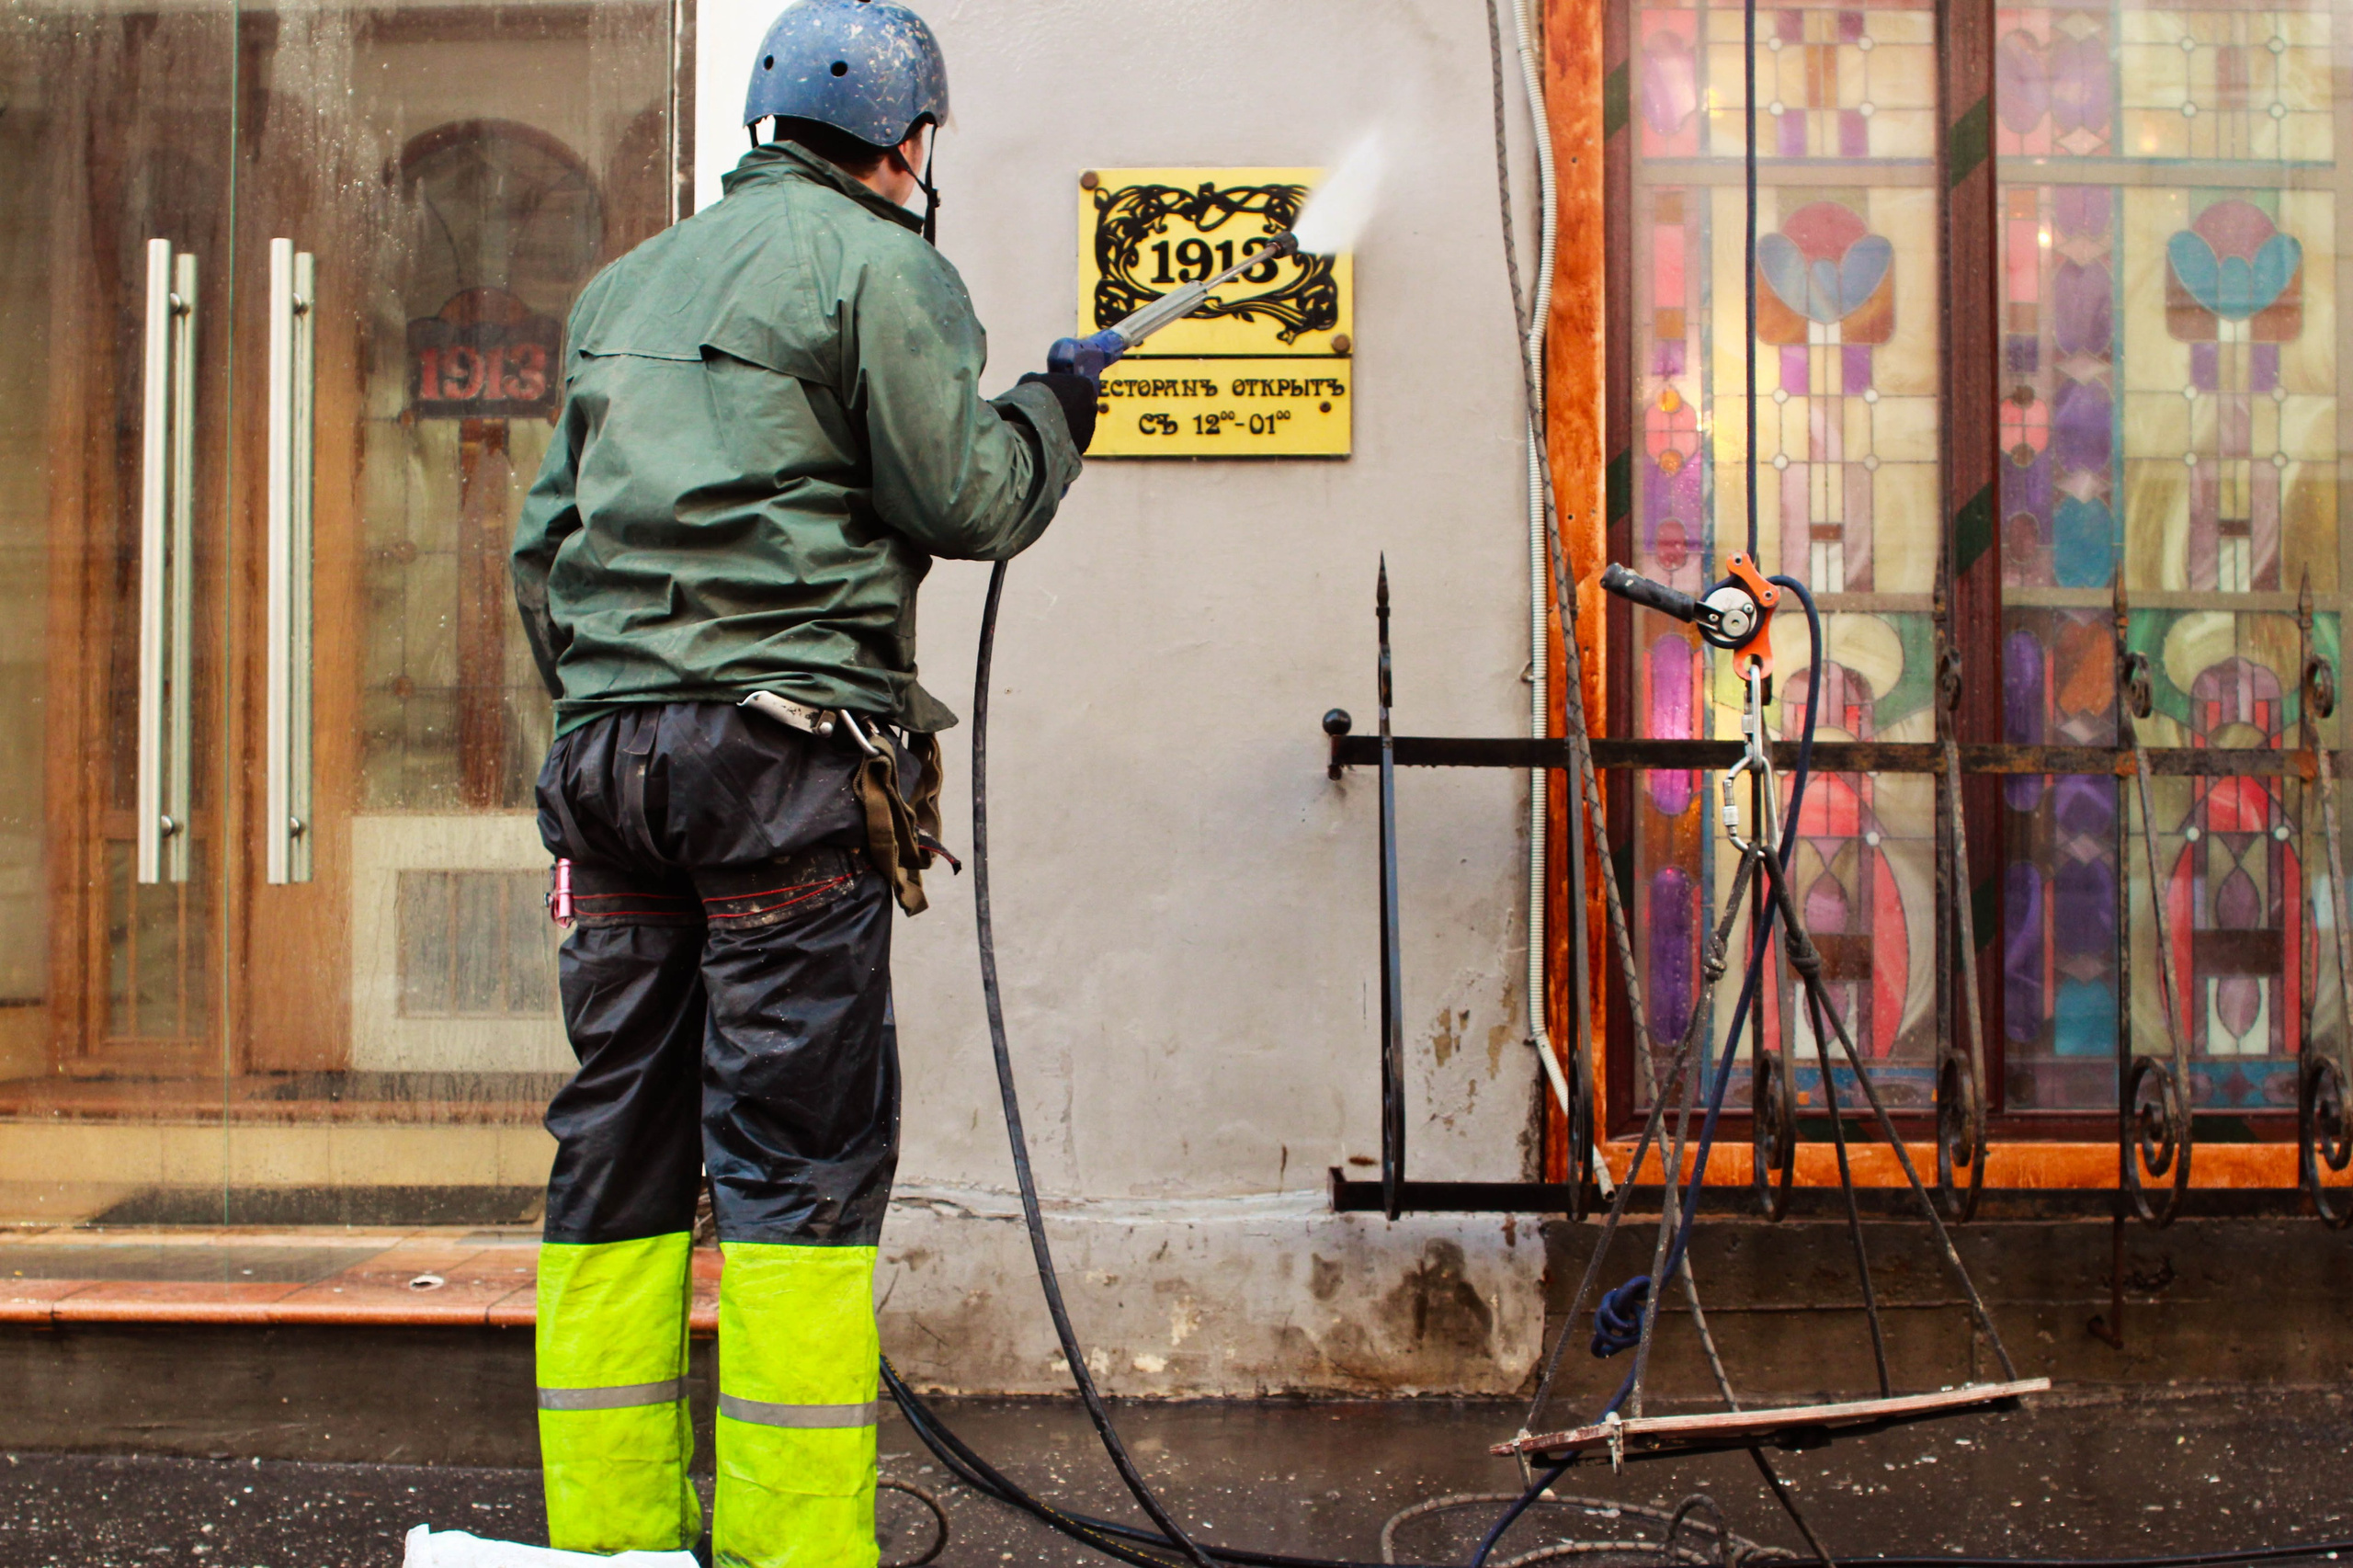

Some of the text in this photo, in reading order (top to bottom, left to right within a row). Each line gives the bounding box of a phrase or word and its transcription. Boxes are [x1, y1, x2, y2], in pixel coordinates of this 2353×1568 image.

[1151, 237, 1279, 283] 1913
[418, 345, 547, 401] 1913
[1099, 378, 1346, 397] ЕСТОРАНЪ ОТКРЫТЪ
[1139, 413, 1178, 435] СЪ
